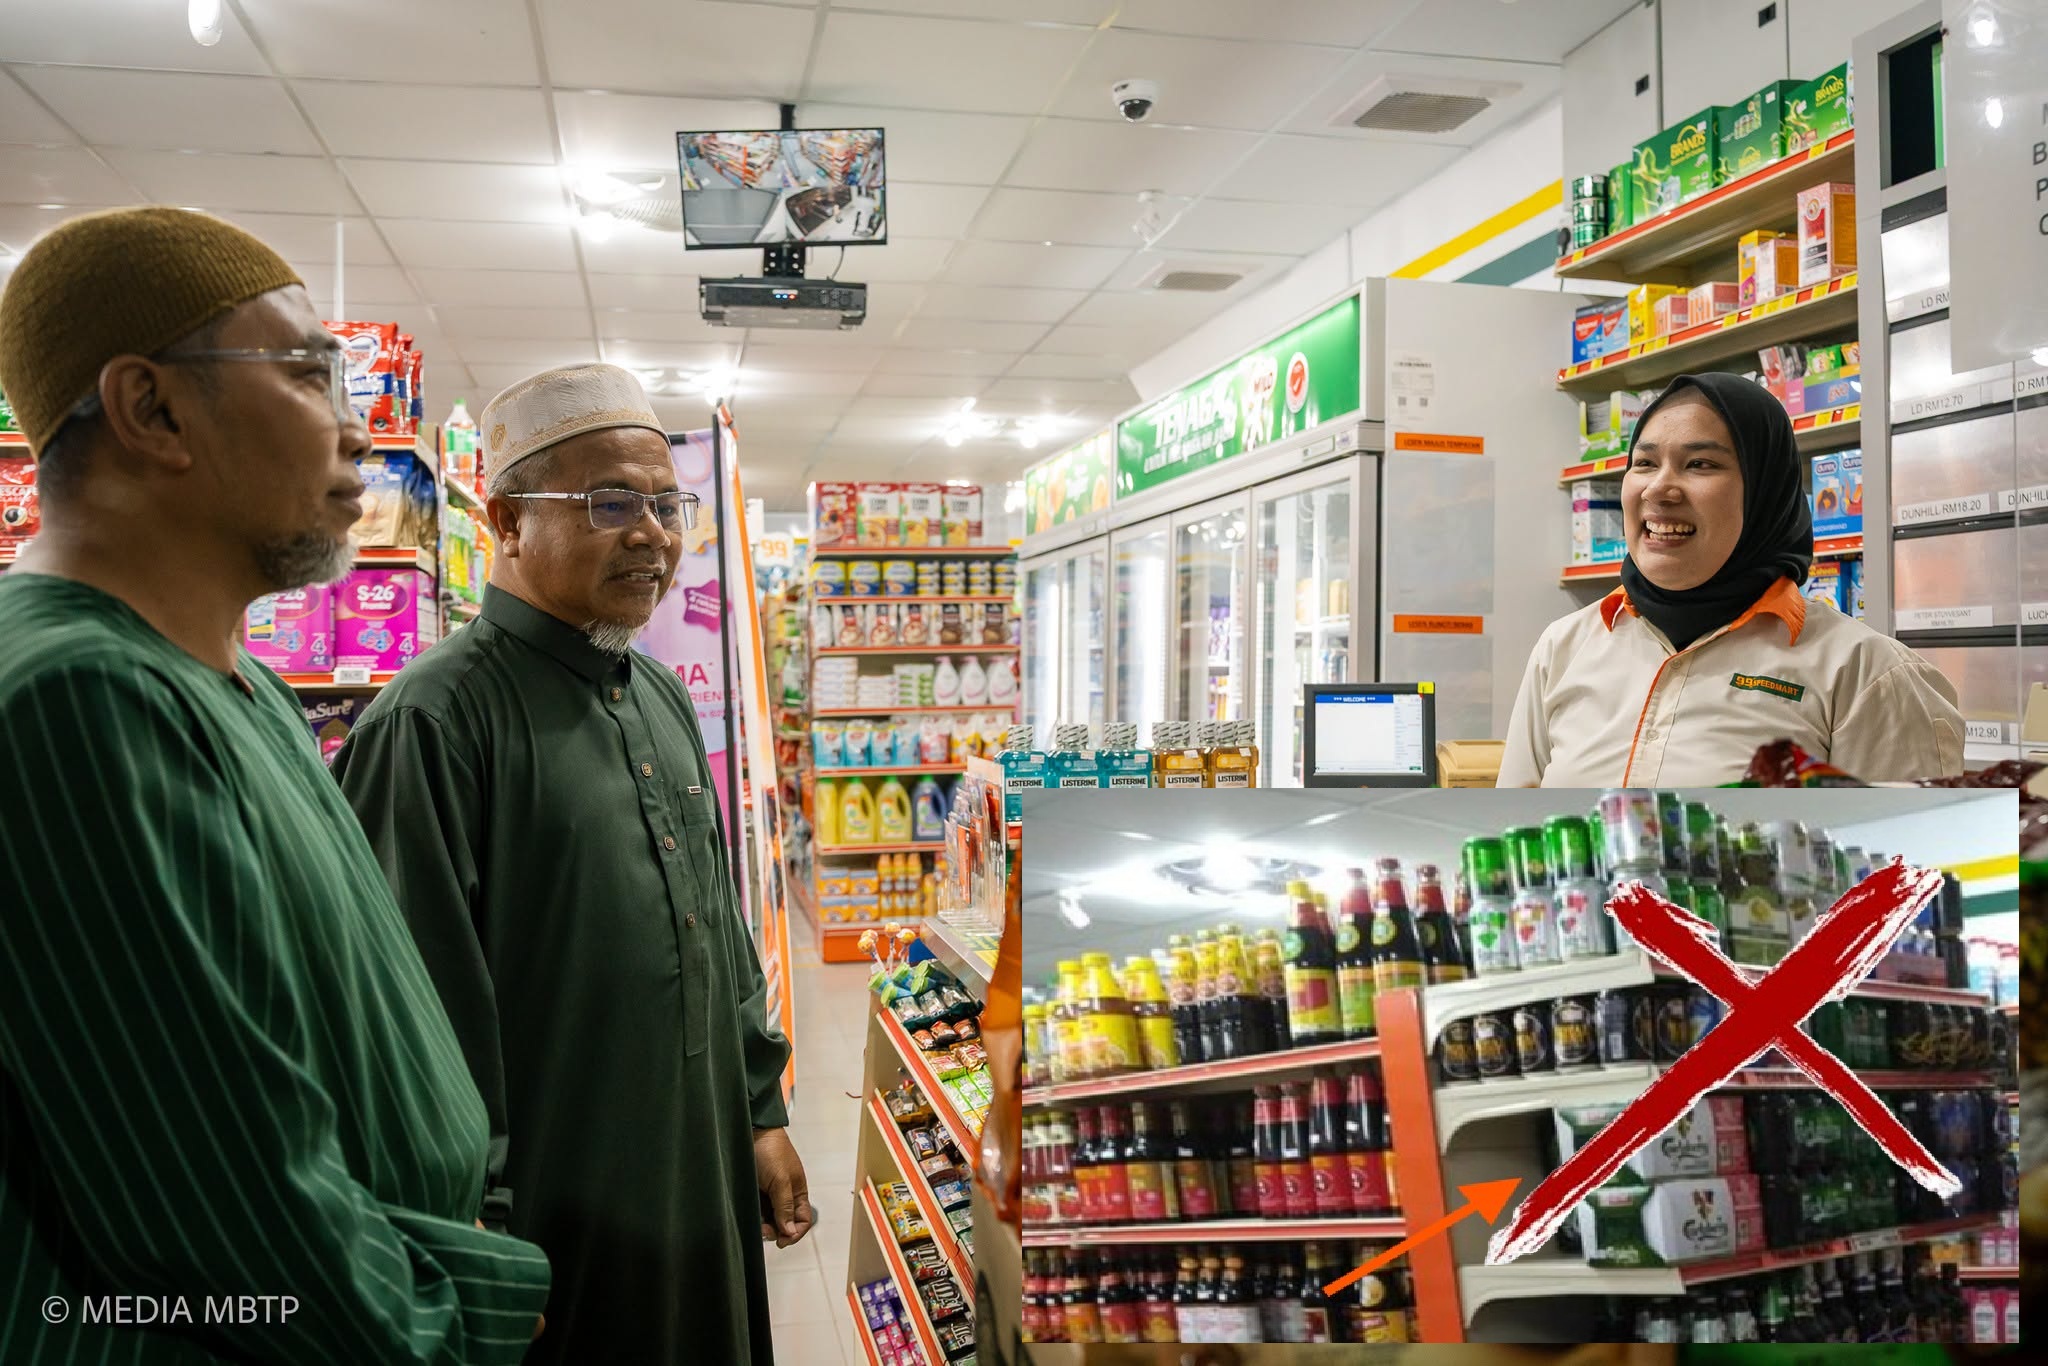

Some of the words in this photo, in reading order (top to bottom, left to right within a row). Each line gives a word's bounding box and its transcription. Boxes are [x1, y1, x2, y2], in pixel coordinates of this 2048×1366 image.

[1911, 403, 1923, 416] LD
[1925, 394, 1964, 412] RM12.70
[1901, 508, 1941, 521] DUNHILL
[1942, 499, 1982, 515] RM18.20
[761, 537, 787, 558] 99
[356, 585, 395, 602] S-26
[1966, 727, 1998, 738] M12.90
[1008, 777, 1043, 788] LISTERINE
[1062, 777, 1097, 788] LISTERINE
[1111, 776, 1147, 787] LISTERINE
[1167, 775, 1201, 786] LISTERINE
[1217, 774, 1248, 784] LISTERINE
